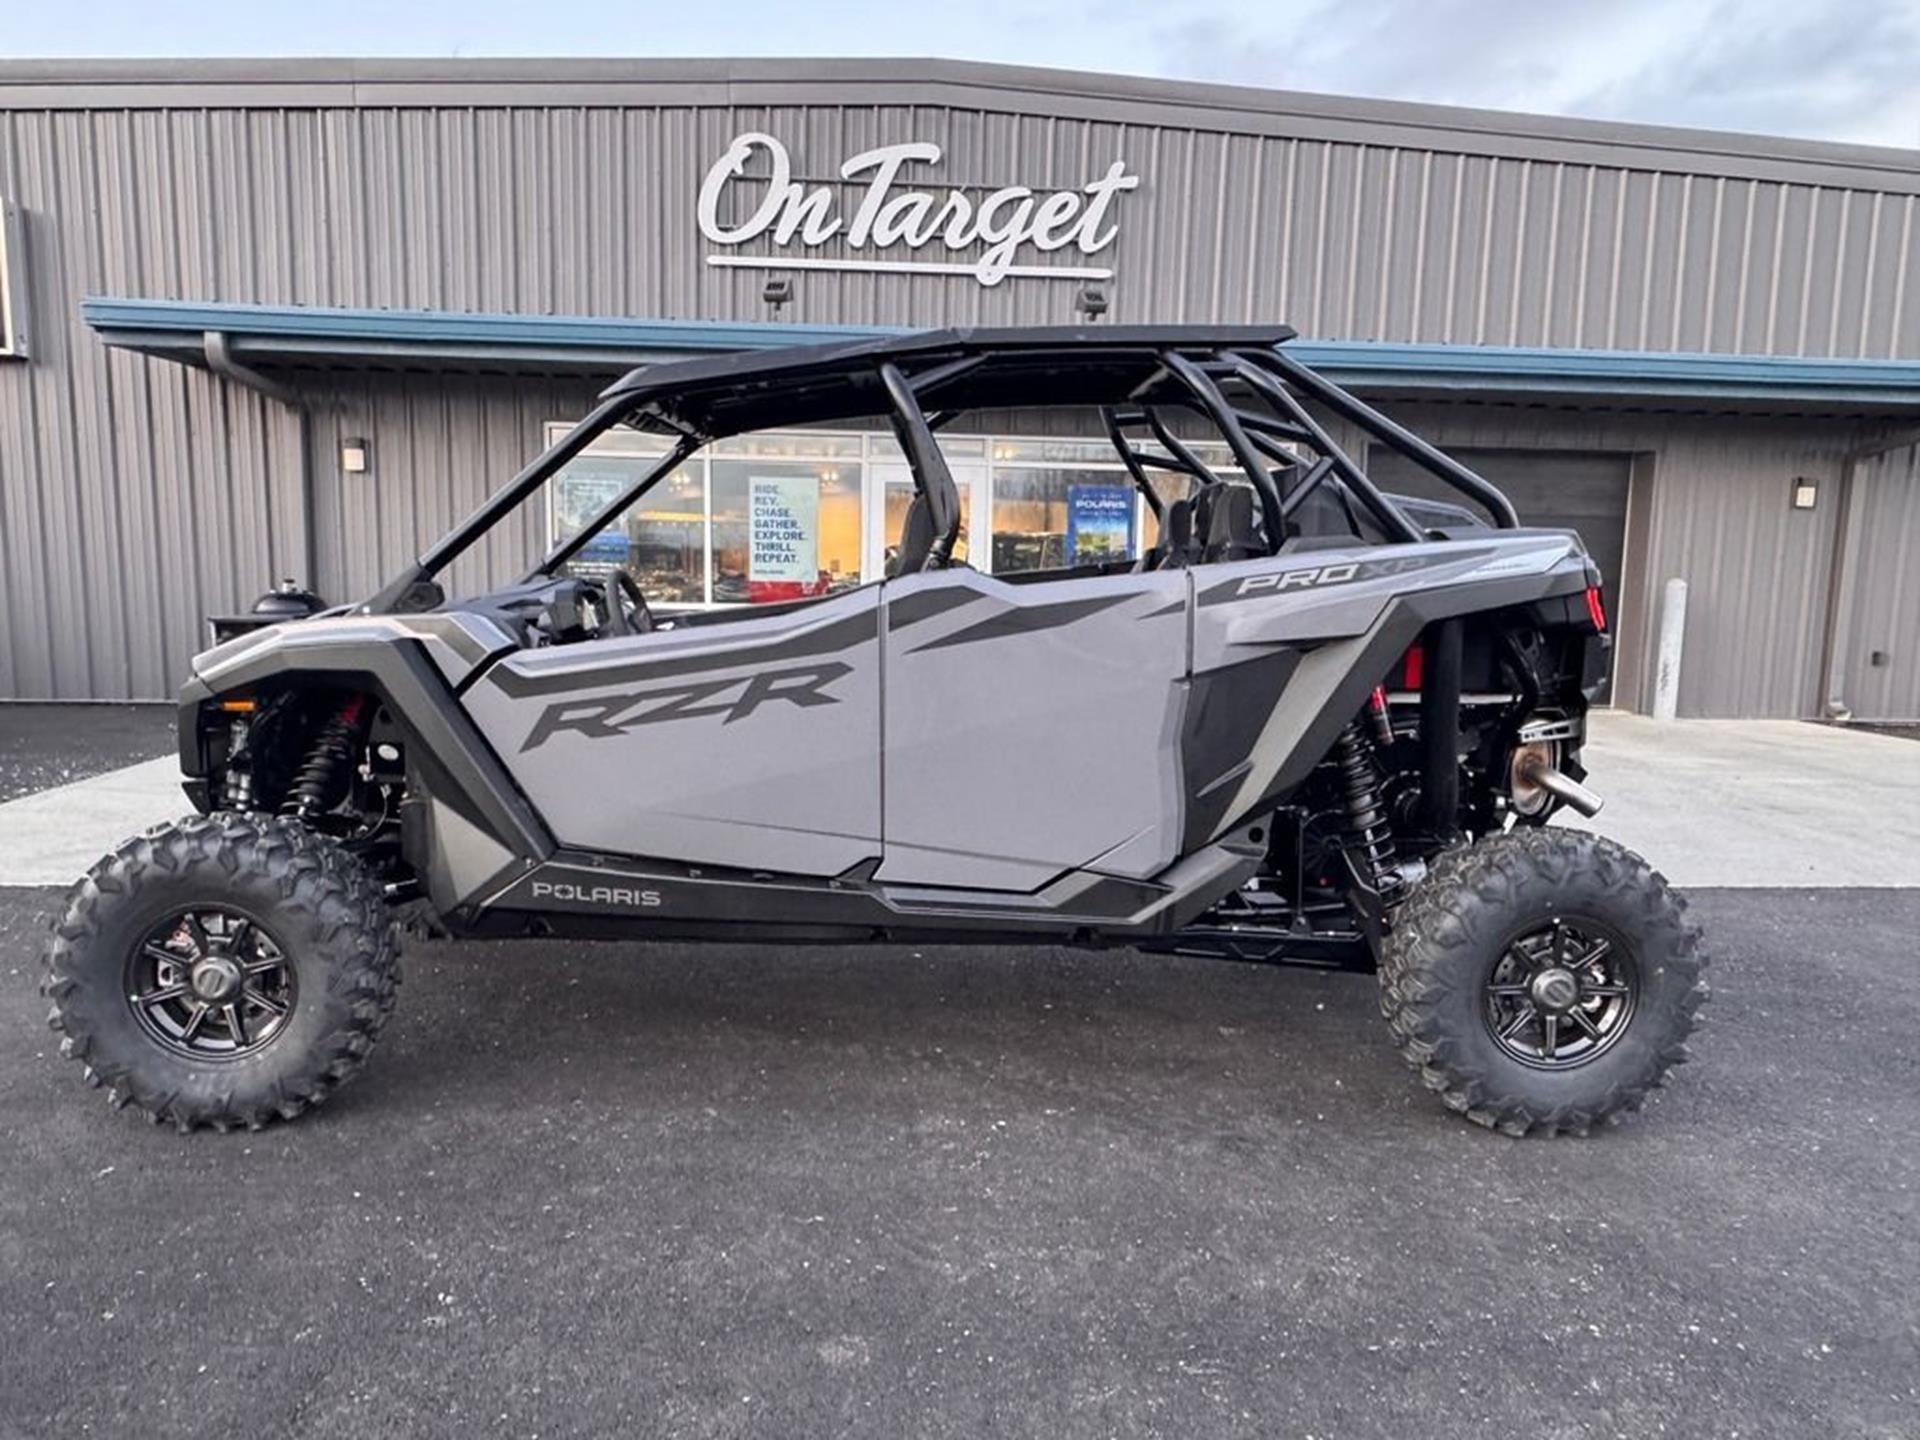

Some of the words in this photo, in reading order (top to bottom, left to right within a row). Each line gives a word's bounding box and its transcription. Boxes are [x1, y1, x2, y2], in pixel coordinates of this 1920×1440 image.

[697, 132, 843, 244] On
[840, 142, 1139, 286] Target
[1075, 500, 1127, 509] POLARIS
[754, 519, 801, 529] GATHER.
[754, 530, 808, 541] EXPLORE.
[754, 542, 796, 552] THRILL.
[754, 553, 800, 564] REPEAT.
[1236, 564, 1360, 595] PRO
[519, 661, 855, 754] RZR
[531, 882, 661, 907] POLARIS
